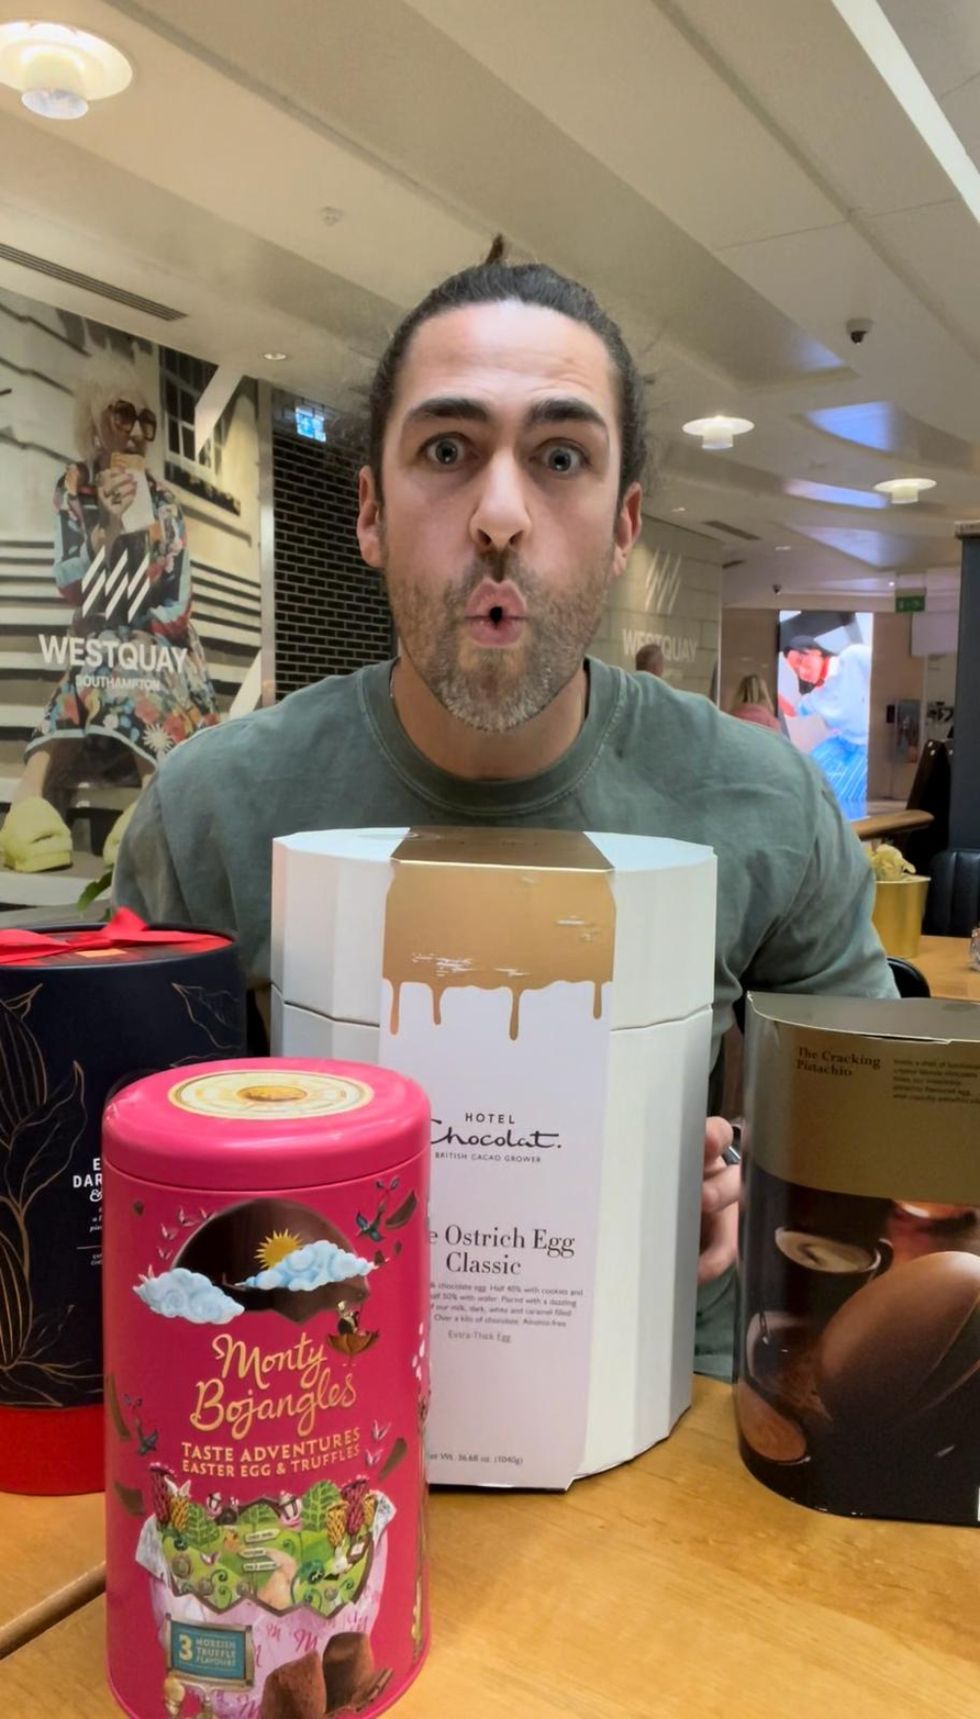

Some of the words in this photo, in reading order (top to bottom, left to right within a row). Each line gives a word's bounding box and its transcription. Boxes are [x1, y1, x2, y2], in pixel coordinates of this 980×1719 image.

[38, 633, 188, 673] WESTQUAY
[75, 674, 160, 692] SOUTHAMPTON
[798, 1047, 818, 1059] The
[821, 1050, 880, 1071] Cracking
[465, 1112, 515, 1125] HOTEL
[435, 1152, 467, 1160] BRITISH
[504, 1155, 541, 1163] GROWER
[73, 1173, 102, 1188] DAR
[445, 1224, 525, 1249] Ostrich
[533, 1228, 575, 1258] Egg
[446, 1251, 521, 1275] Classic
[212, 1332, 327, 1389] Monty
[190, 1368, 357, 1440] Bojangles
[181, 1442, 234, 1462] TASTE
[240, 1427, 361, 1462] ADVENTURES
[182, 1460, 235, 1477] EASTER
[240, 1463, 271, 1477] EGG
[276, 1462, 286, 1474] &
[290, 1444, 361, 1473] TRUFFLES
[179, 1634, 192, 1661] 3
